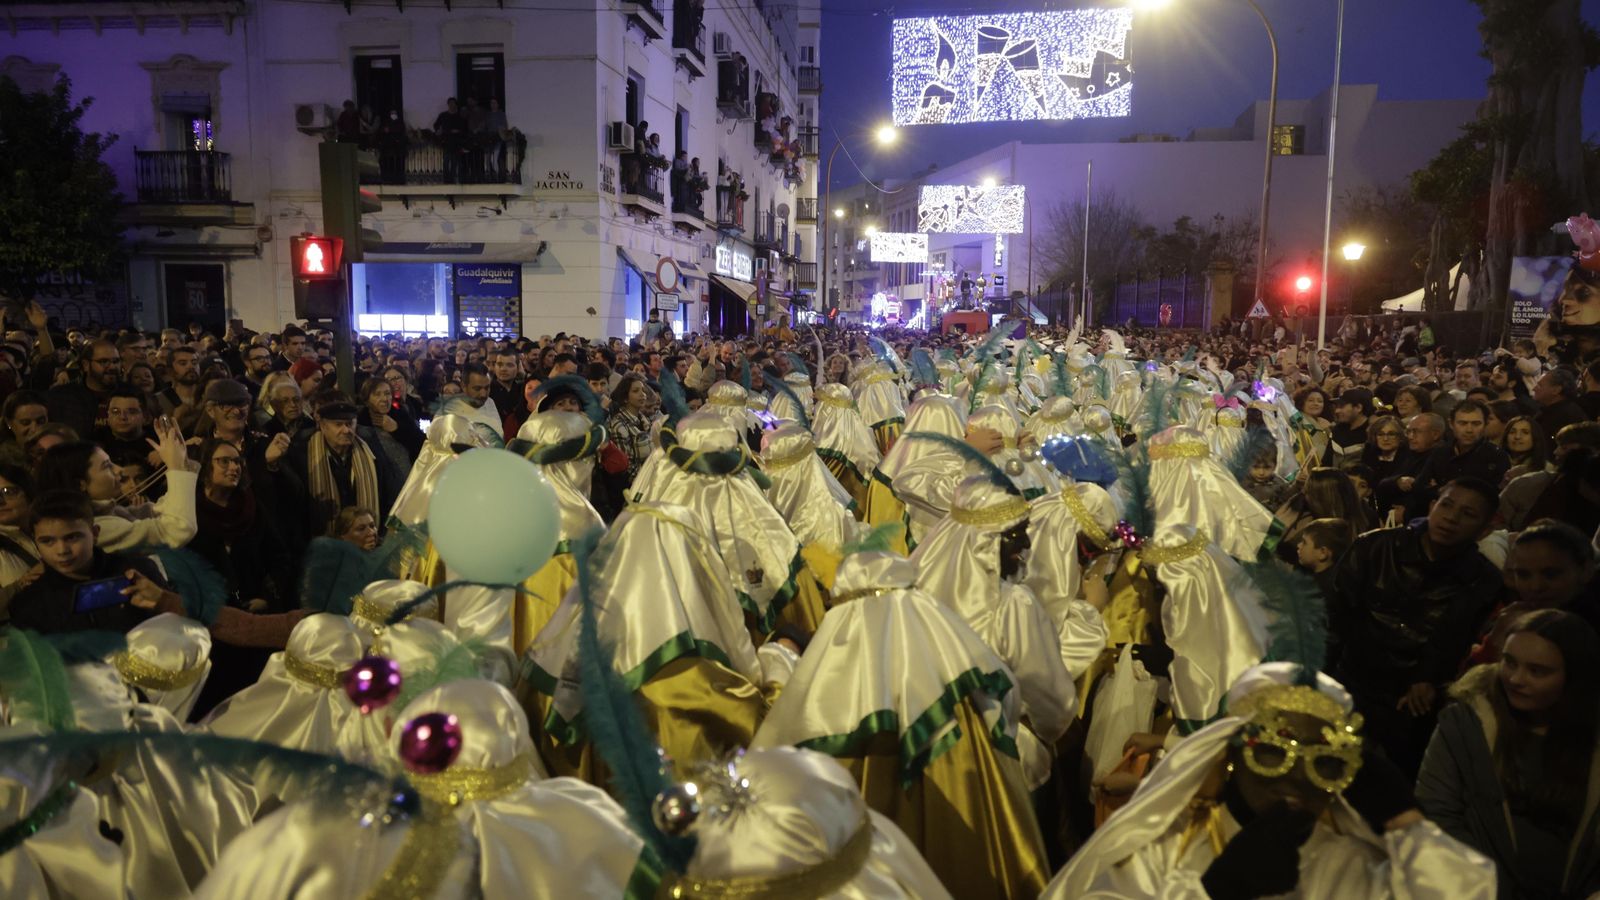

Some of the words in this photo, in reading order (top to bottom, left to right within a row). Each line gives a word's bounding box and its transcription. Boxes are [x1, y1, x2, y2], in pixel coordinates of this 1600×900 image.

[548, 170, 570, 179] SAN
[535, 181, 584, 189] JACINTO
[457, 267, 515, 278] Guadalquivir
